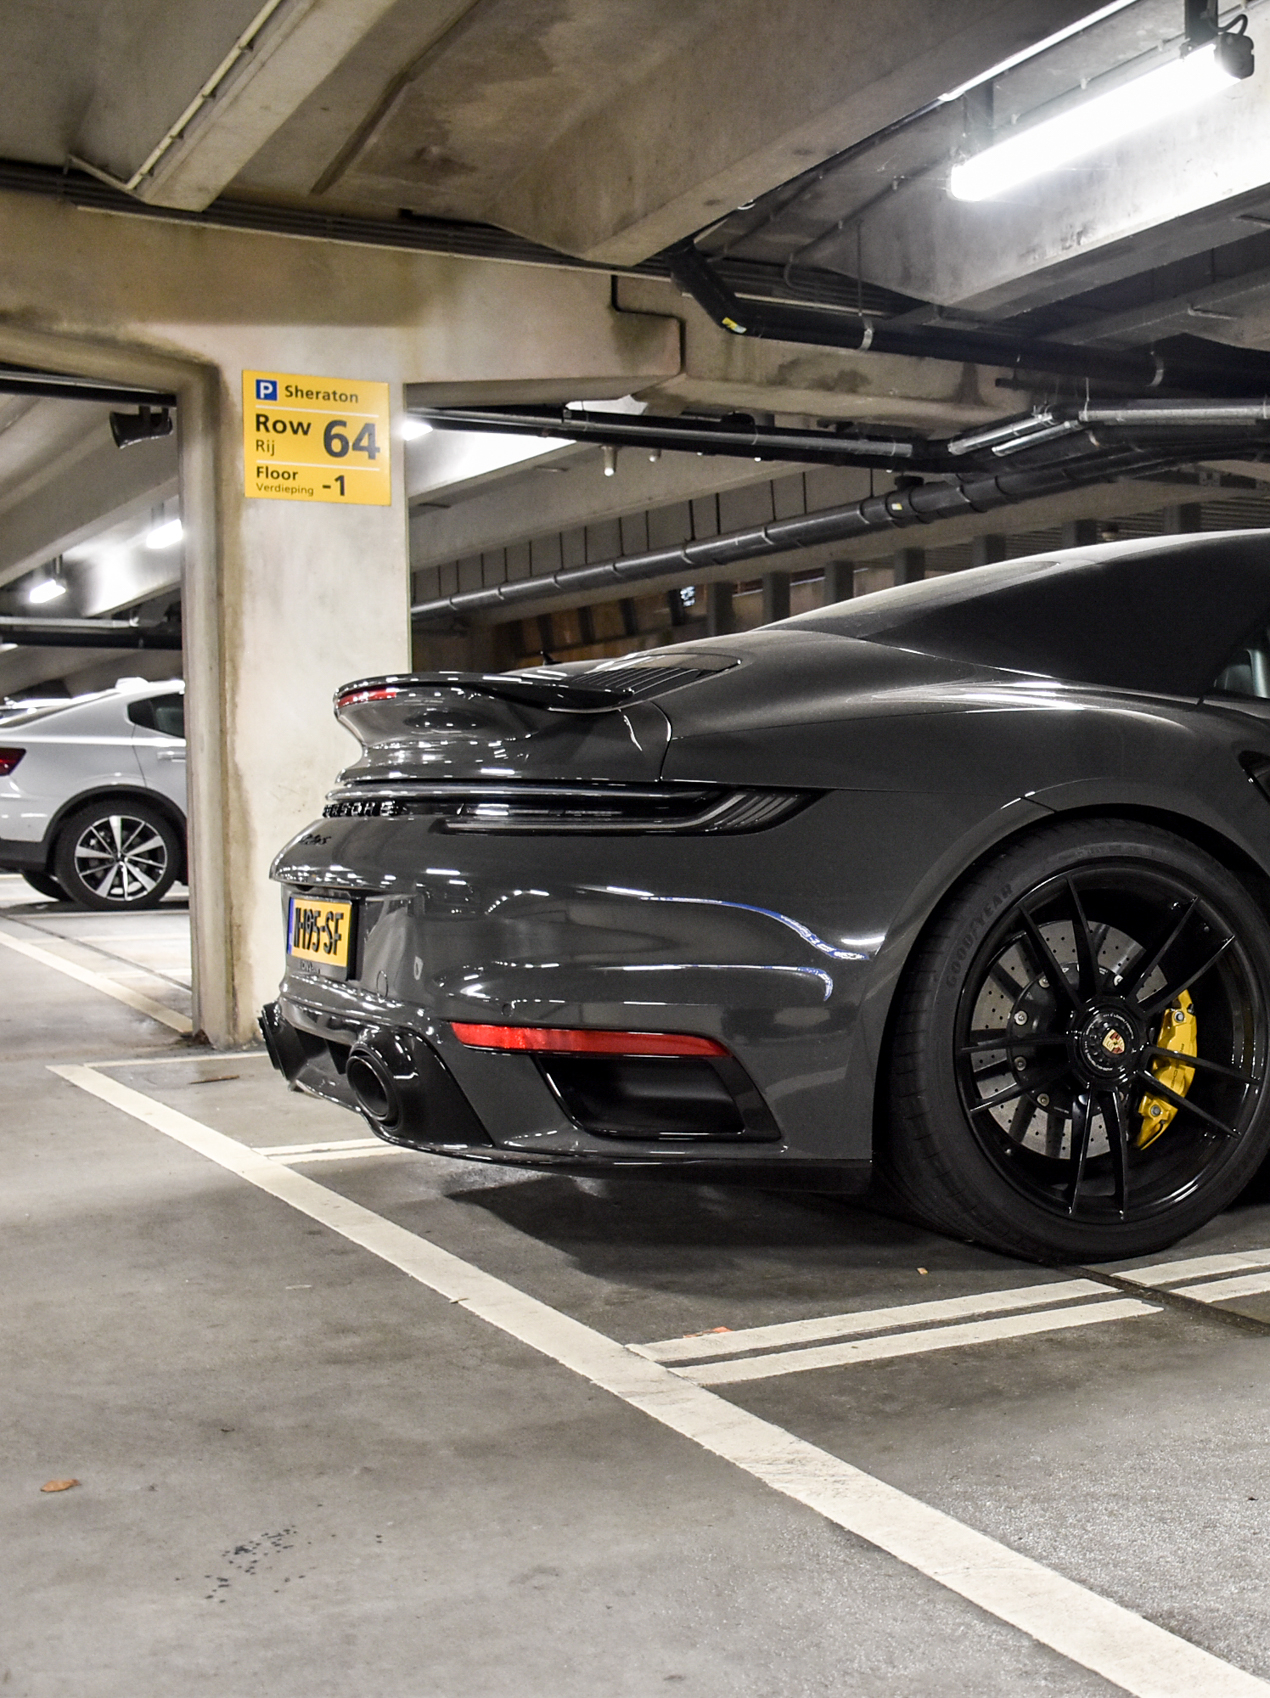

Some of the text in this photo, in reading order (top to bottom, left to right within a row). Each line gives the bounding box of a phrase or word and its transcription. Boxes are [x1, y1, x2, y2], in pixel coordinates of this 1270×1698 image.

[260, 382, 359, 403] P Sheraton
[255, 413, 381, 460] Row 64
[256, 439, 275, 456] Rij
[256, 466, 345, 496] Floor -1
[256, 483, 314, 497] Verdieping
